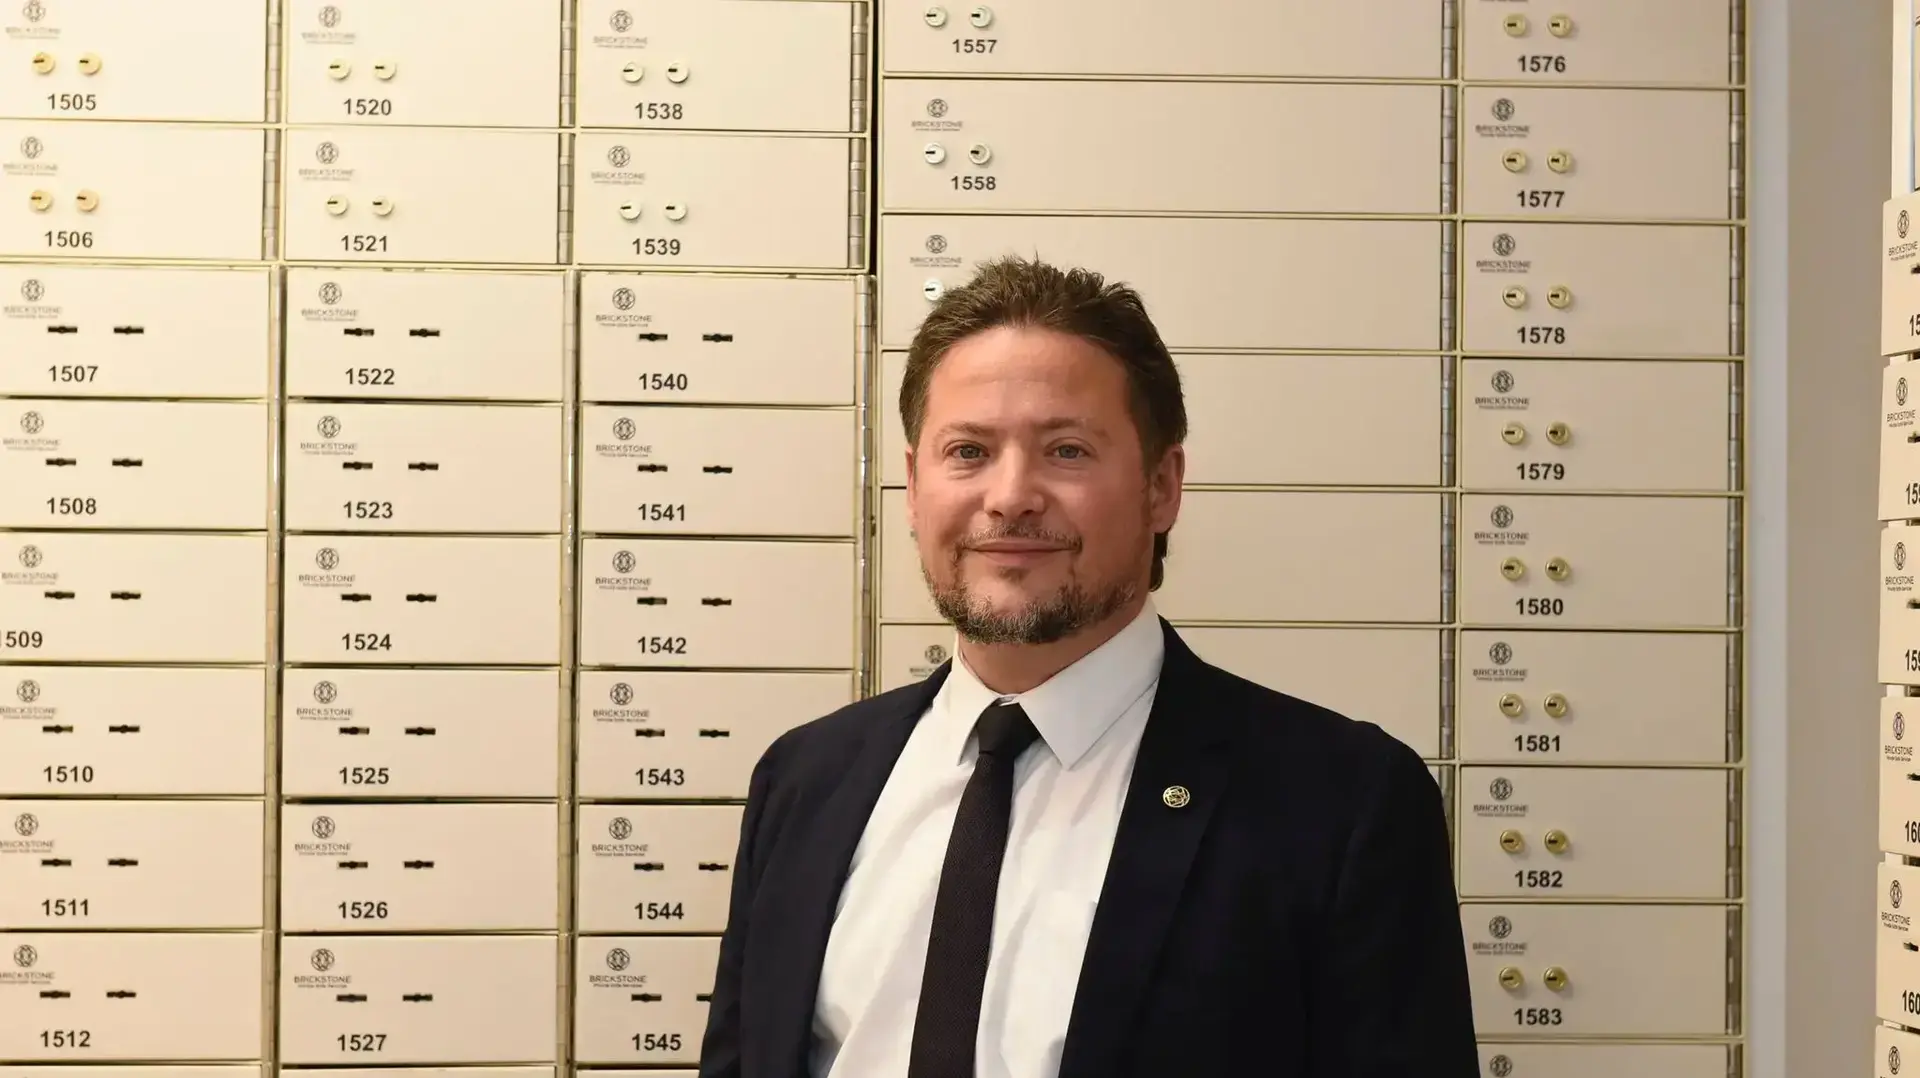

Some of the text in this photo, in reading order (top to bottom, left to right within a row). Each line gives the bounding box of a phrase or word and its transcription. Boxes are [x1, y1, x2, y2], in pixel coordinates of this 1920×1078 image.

[952, 39, 998, 54] 1557
[1518, 56, 1566, 74] 1576
[47, 94, 97, 112] 1505
[343, 99, 392, 117] 1520
[634, 103, 683, 121] 1538
[1475, 125, 1530, 133] BRICKSTONE
[591, 172, 645, 180] BRICKSTONE
[951, 176, 997, 191] 1558
[1517, 191, 1565, 208] 1577
[44, 231, 93, 249] 1506
[341, 235, 387, 253] 1521
[632, 238, 681, 256] 1539
[1888, 241, 1918, 256] BRICKSTONE
[1476, 261, 1531, 269] BRICKSTONE
[301, 309, 359, 317] BRICKSTONE
[596, 315, 652, 323] BRICKSTONE
[1517, 327, 1566, 345] 1578
[48, 365, 99, 383] 1507
[345, 368, 395, 386] 1522
[638, 373, 688, 391] 1540
[1475, 397, 1529, 405] BRICKSTONE
[1887, 409, 1916, 422] BRICKSTONE
[300, 443, 357, 451] BRICKSTONE
[596, 445, 651, 453] BRICKSTONE
[1516, 463, 1565, 481] 1579
[46, 498, 97, 516] 1508
[343, 502, 394, 519] 1523
[638, 504, 685, 522] 1541
[1474, 532, 1529, 540] BRICKSTONE
[2, 573, 59, 581] BRICKSTONE
[299, 575, 355, 583] BRICKSTONE
[595, 578, 651, 586] BRICKSTONE
[1885, 576, 1914, 585] BRICKSTONE
[1515, 598, 1564, 616] 1580
[0, 630, 43, 649] 509
[341, 634, 392, 651] 1524
[637, 637, 687, 655] 1542
[1473, 669, 1527, 677] BRICKSTONE
[296, 708, 353, 717] BRICKSTONE
[593, 710, 649, 718] BRICKSTONE
[1514, 735, 1561, 753] 1581
[1884, 745, 1913, 756] BRICKSTONE
[43, 766, 94, 783] 1510
[339, 767, 390, 785] 1525
[635, 769, 685, 786] 1543
[1473, 805, 1528, 813] BRICKSTONE
[295, 844, 351, 852] BRICKSTONE
[592, 844, 648, 853] BRICKSTONE
[1514, 871, 1563, 888] 1582
[41, 899, 89, 917] 1511
[338, 902, 388, 919] 1526
[634, 903, 685, 921] 1544
[1881, 912, 1911, 926] BRICKSTONE
[1473, 943, 1527, 951] BRICKSTONE
[0, 972, 54, 980] RICKSTONE
[294, 976, 351, 984] BRICKSTONE
[589, 975, 646, 983] BRICKSTONE
[1514, 1008, 1563, 1026] 1583
[40, 1031, 91, 1048] 1512
[337, 1034, 388, 1052] 1527
[631, 1034, 682, 1052] 1545
